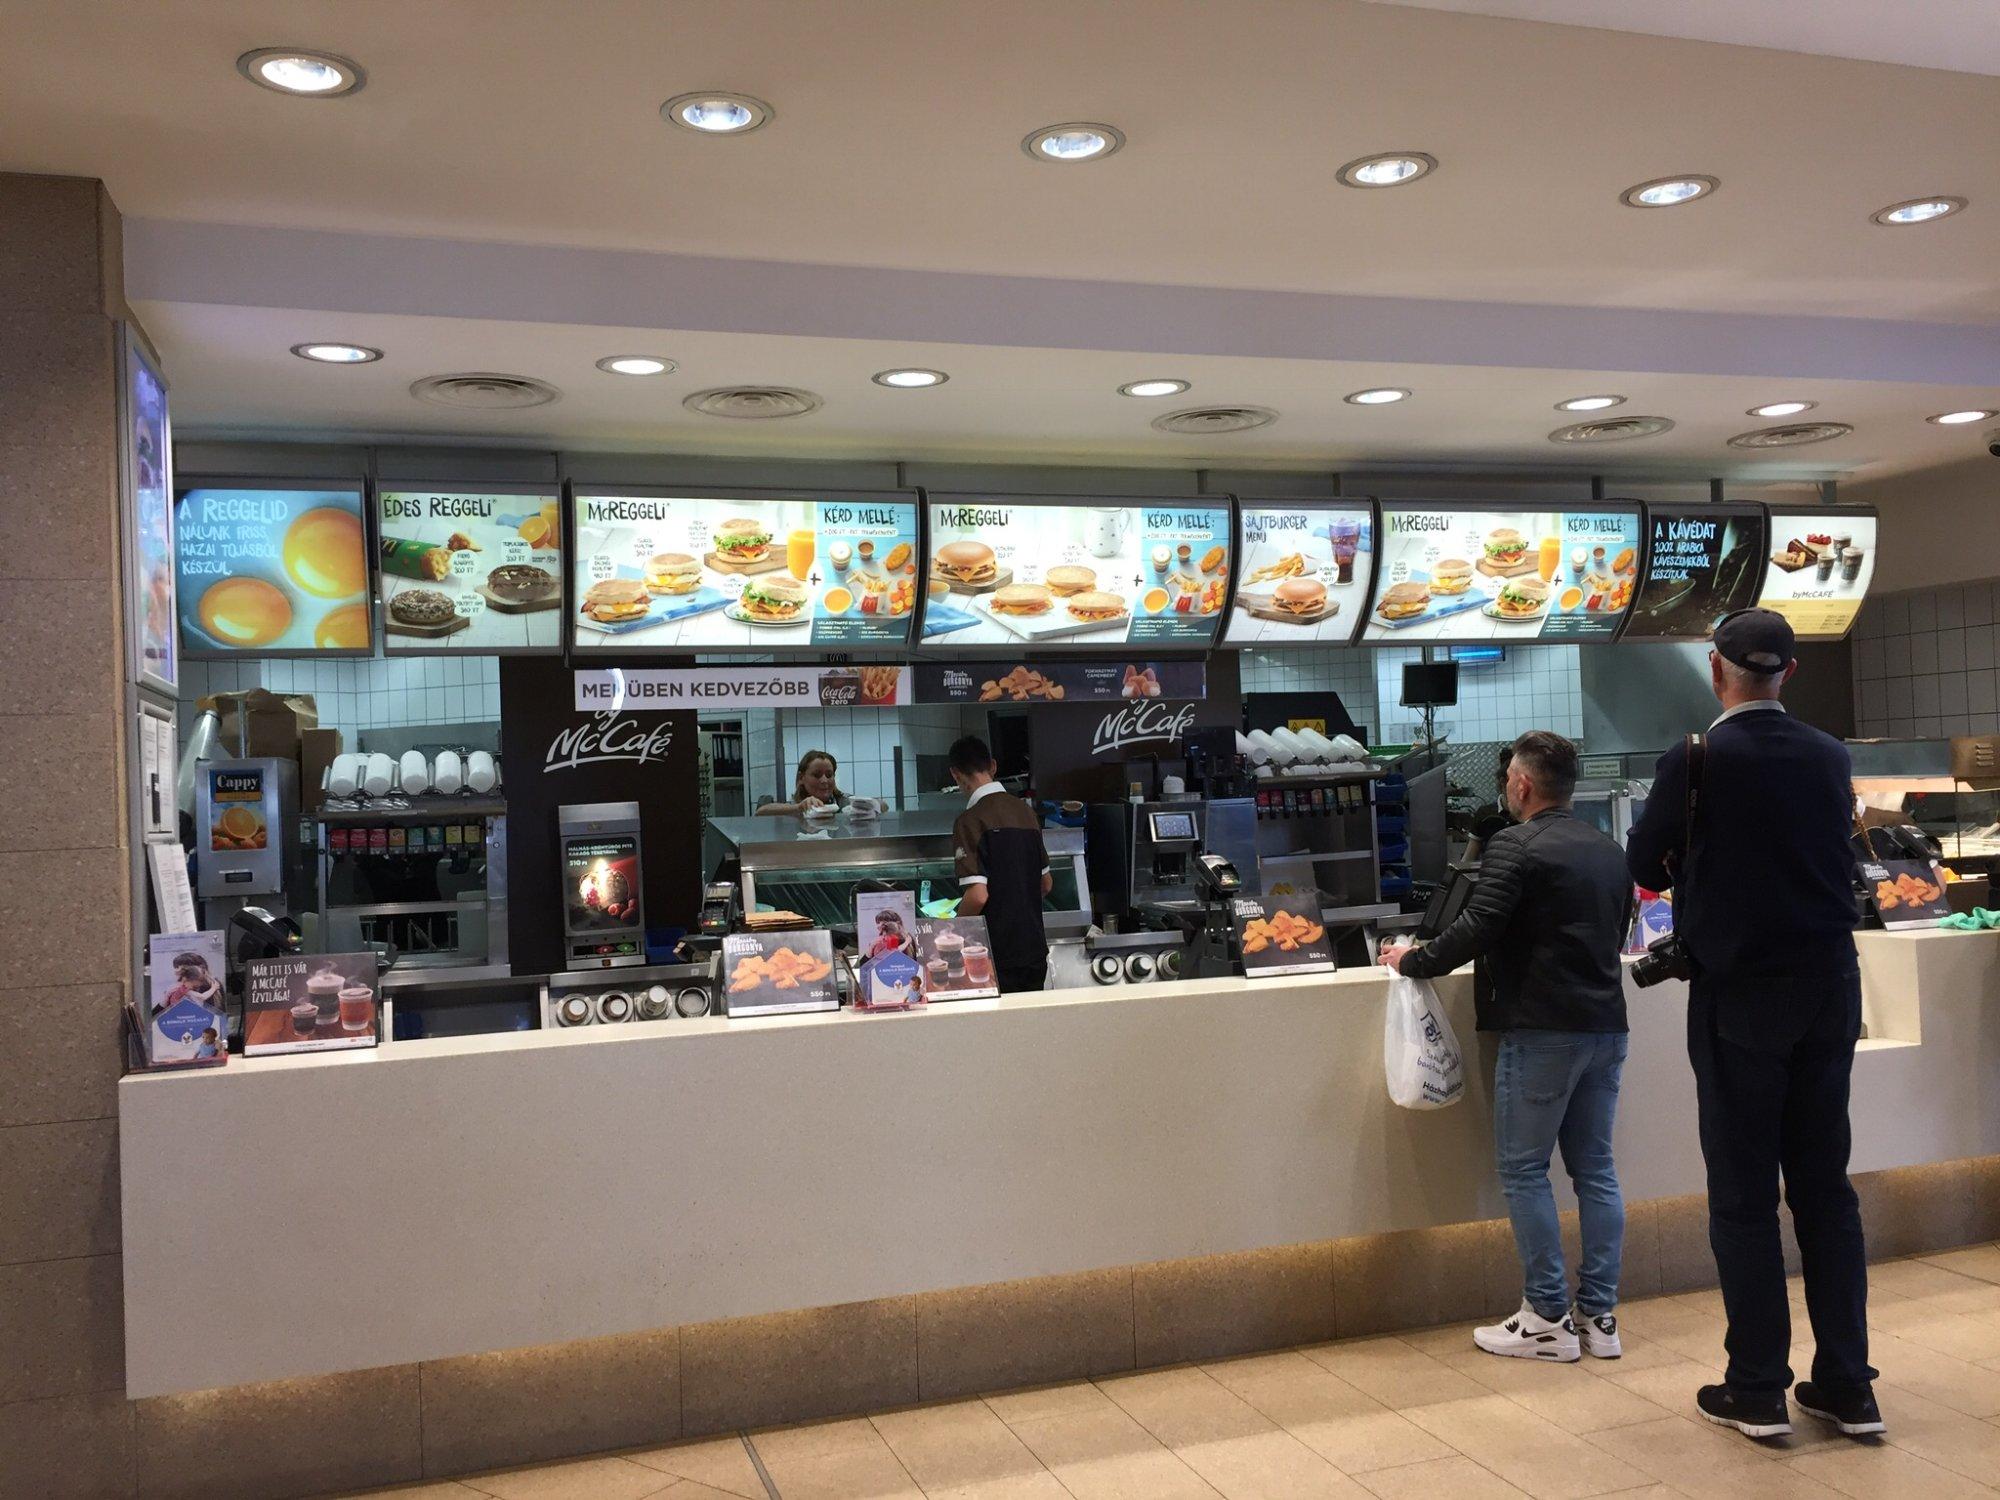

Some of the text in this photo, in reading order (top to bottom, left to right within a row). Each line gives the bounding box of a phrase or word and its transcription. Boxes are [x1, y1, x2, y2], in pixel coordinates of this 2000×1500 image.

[179, 498, 288, 524] A REGGELID
[384, 495, 422, 518] ÉDES
[824, 506, 901, 525] KÉRD MELLÉ:
[1147, 511, 1215, 529] KÉRD MELLÉ:
[1245, 515, 1308, 530] SAJTBURGER
[1567, 515, 1626, 532] KÉRD MELLÉ:
[180, 521, 231, 541] NÁLUNK
[1655, 518, 1716, 540] A KÁVÉDAT
[181, 542, 216, 556] HAZAI
[1655, 541, 1704, 553] 100% ARABICA
[690, 678, 810, 697] KEDVEZŐBB
[545, 719, 673, 769] McCafé
[217, 774, 258, 790] Cappy
[252, 961, 307, 977] MÁR ITT IS VÁR
[252, 979, 257, 990] A
[252, 989, 290, 1003] ÍZVILÁGA!
